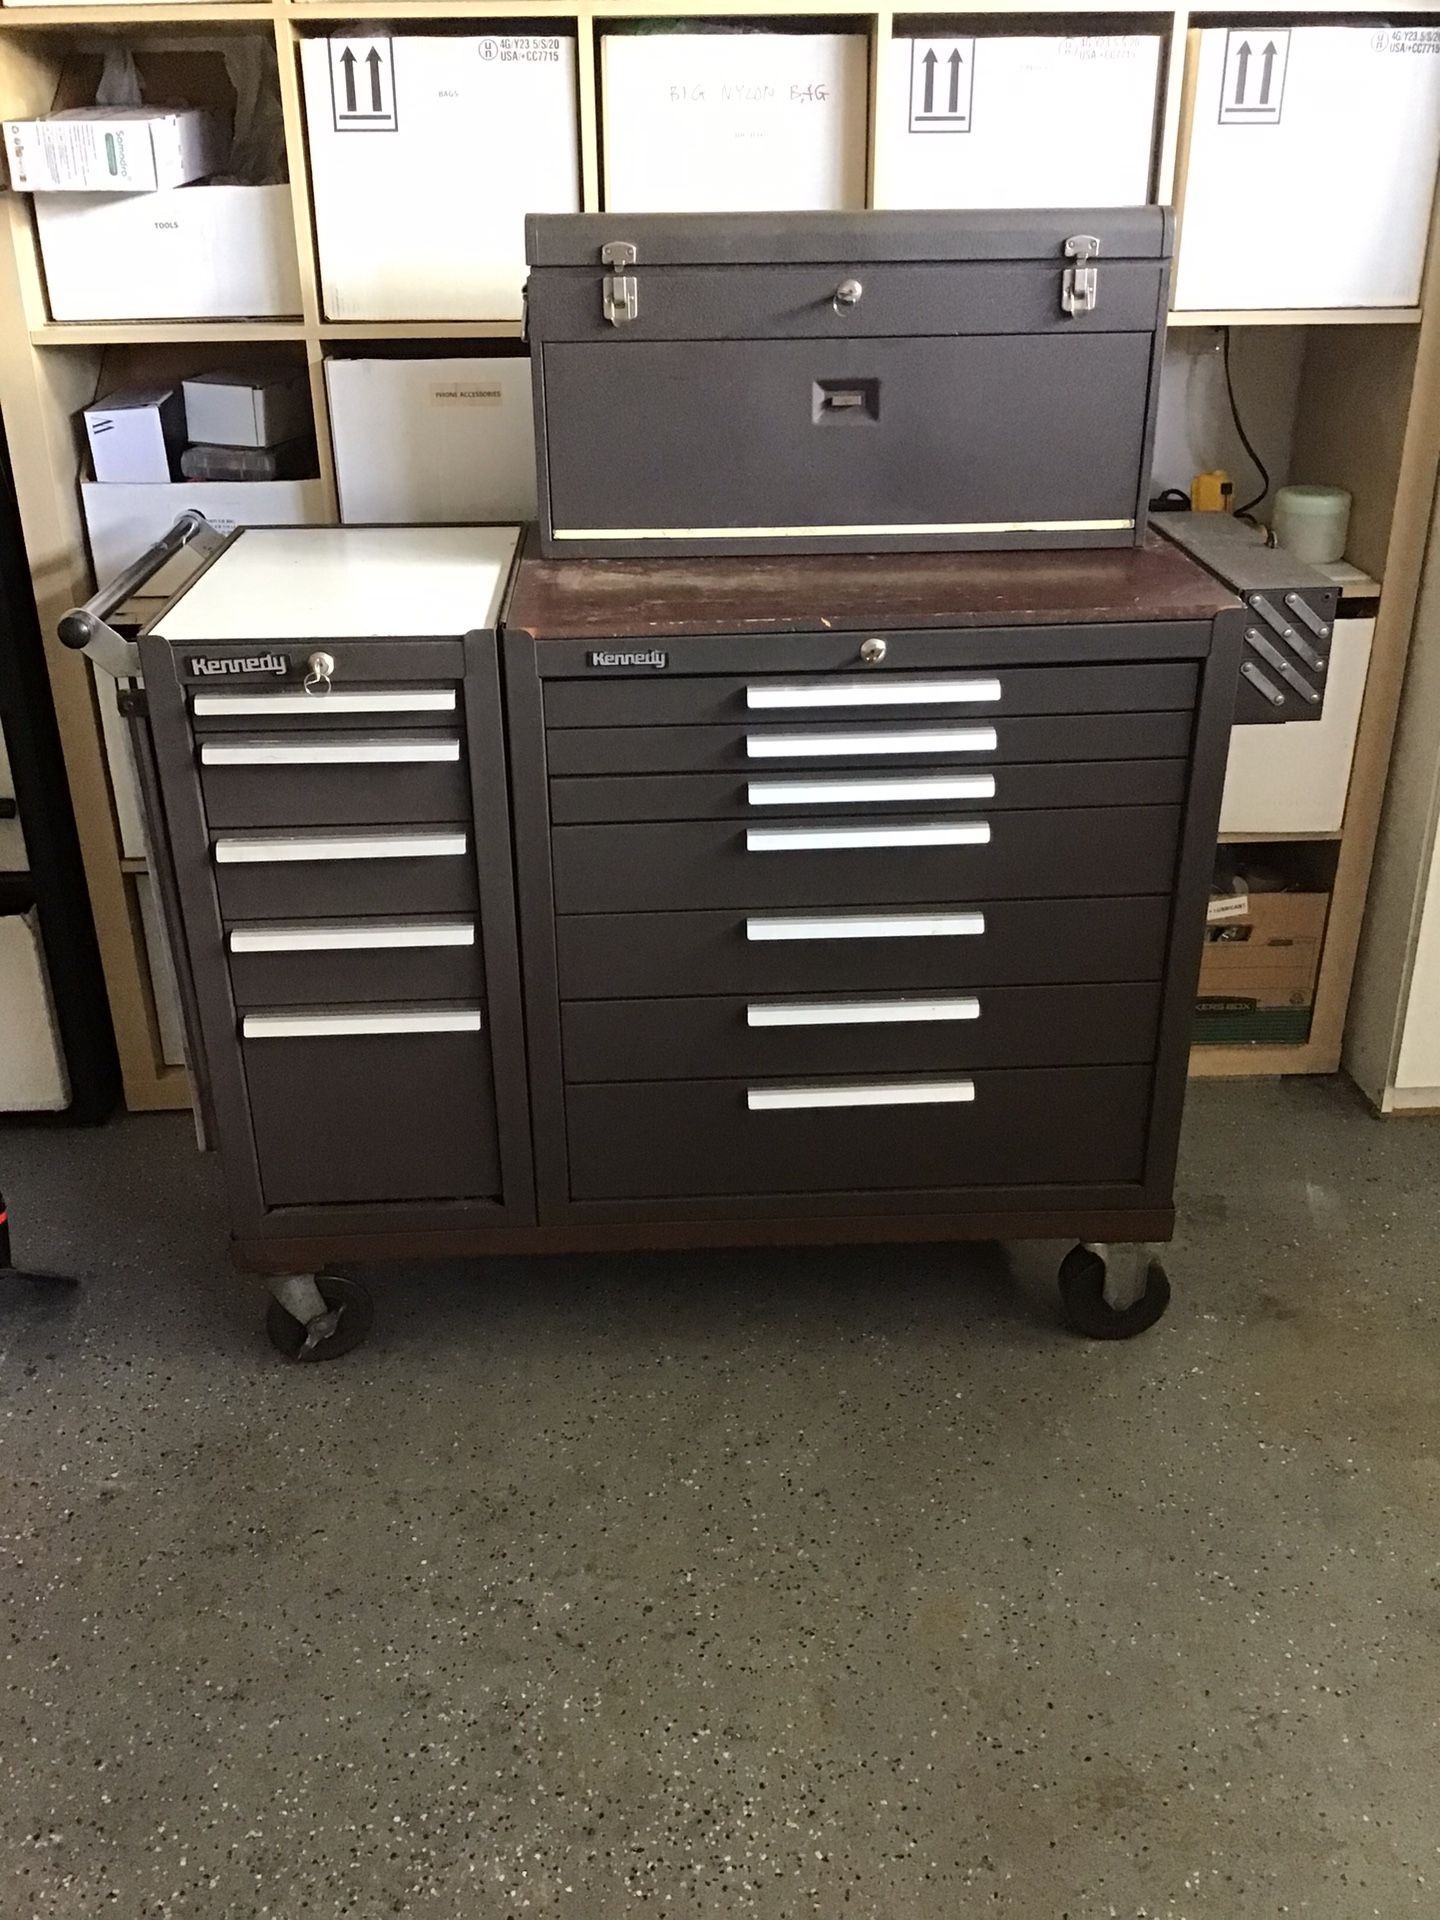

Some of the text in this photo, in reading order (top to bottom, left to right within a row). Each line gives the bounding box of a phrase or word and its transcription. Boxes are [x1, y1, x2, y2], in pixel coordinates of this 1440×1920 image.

[669, 84, 706, 102] BIG
[191, 654, 287, 676] Kennedy
[592, 651, 666, 669] Kennedy
